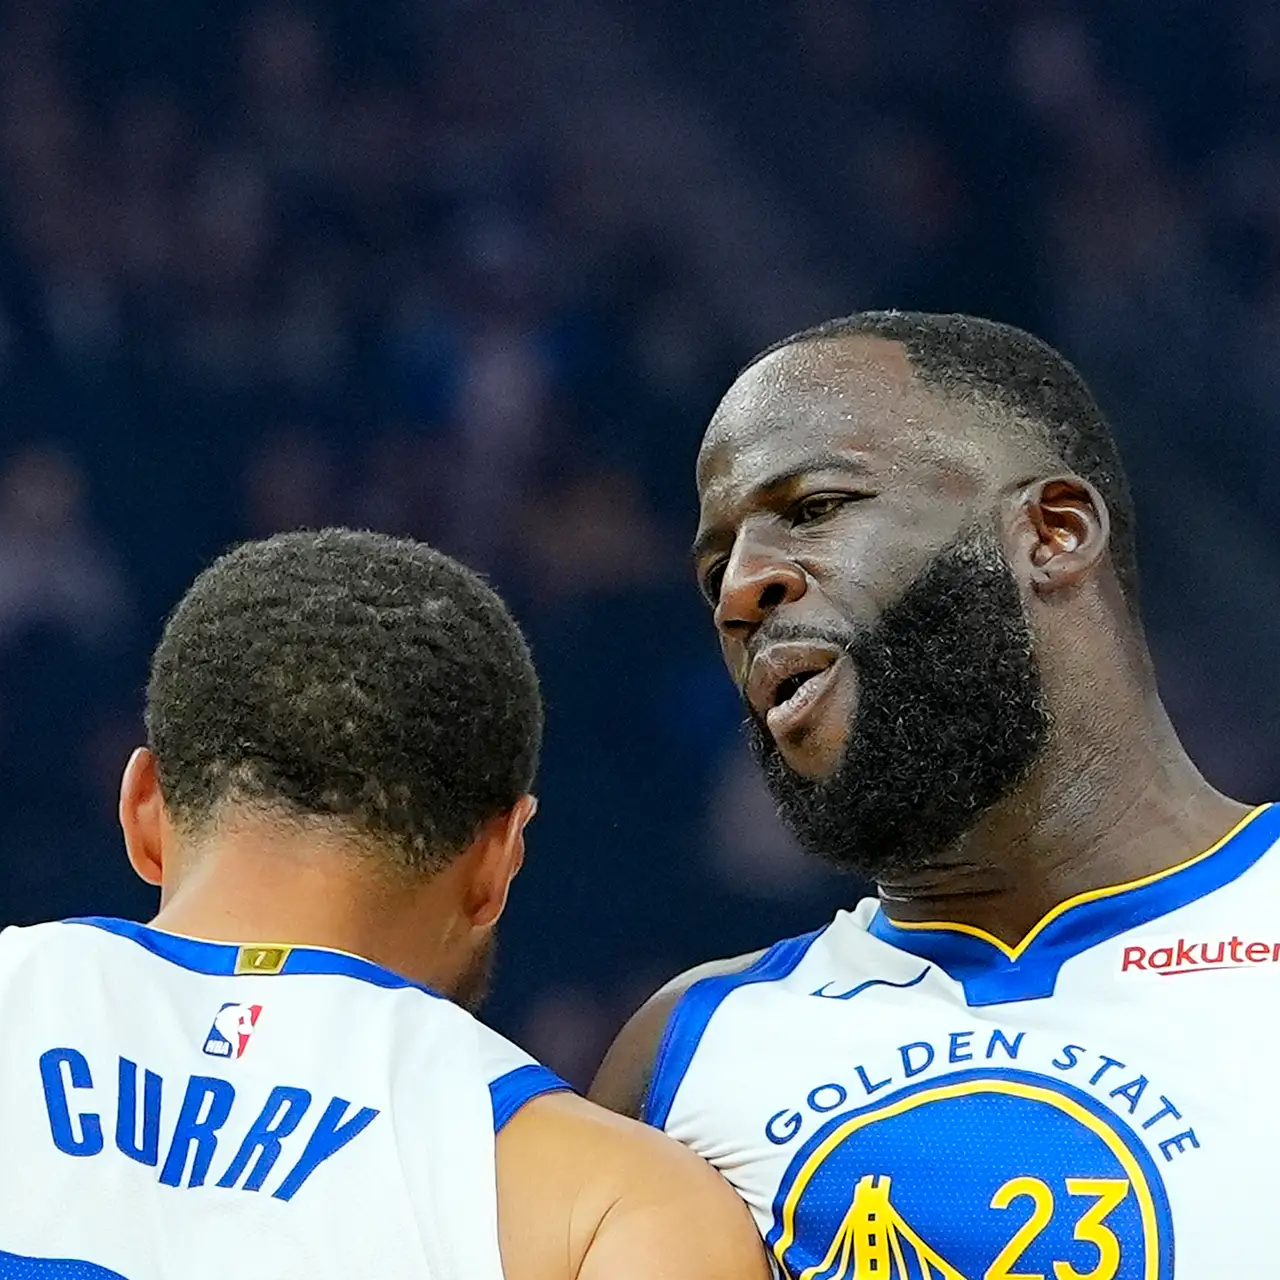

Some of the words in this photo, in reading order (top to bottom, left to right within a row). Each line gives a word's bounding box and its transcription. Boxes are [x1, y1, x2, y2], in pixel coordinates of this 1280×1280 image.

[205, 1040, 230, 1055] NBA
[764, 1028, 1027, 1146] GOLDEN
[1051, 1043, 1201, 1163] STATE
[38, 1047, 381, 1203] CURRY
